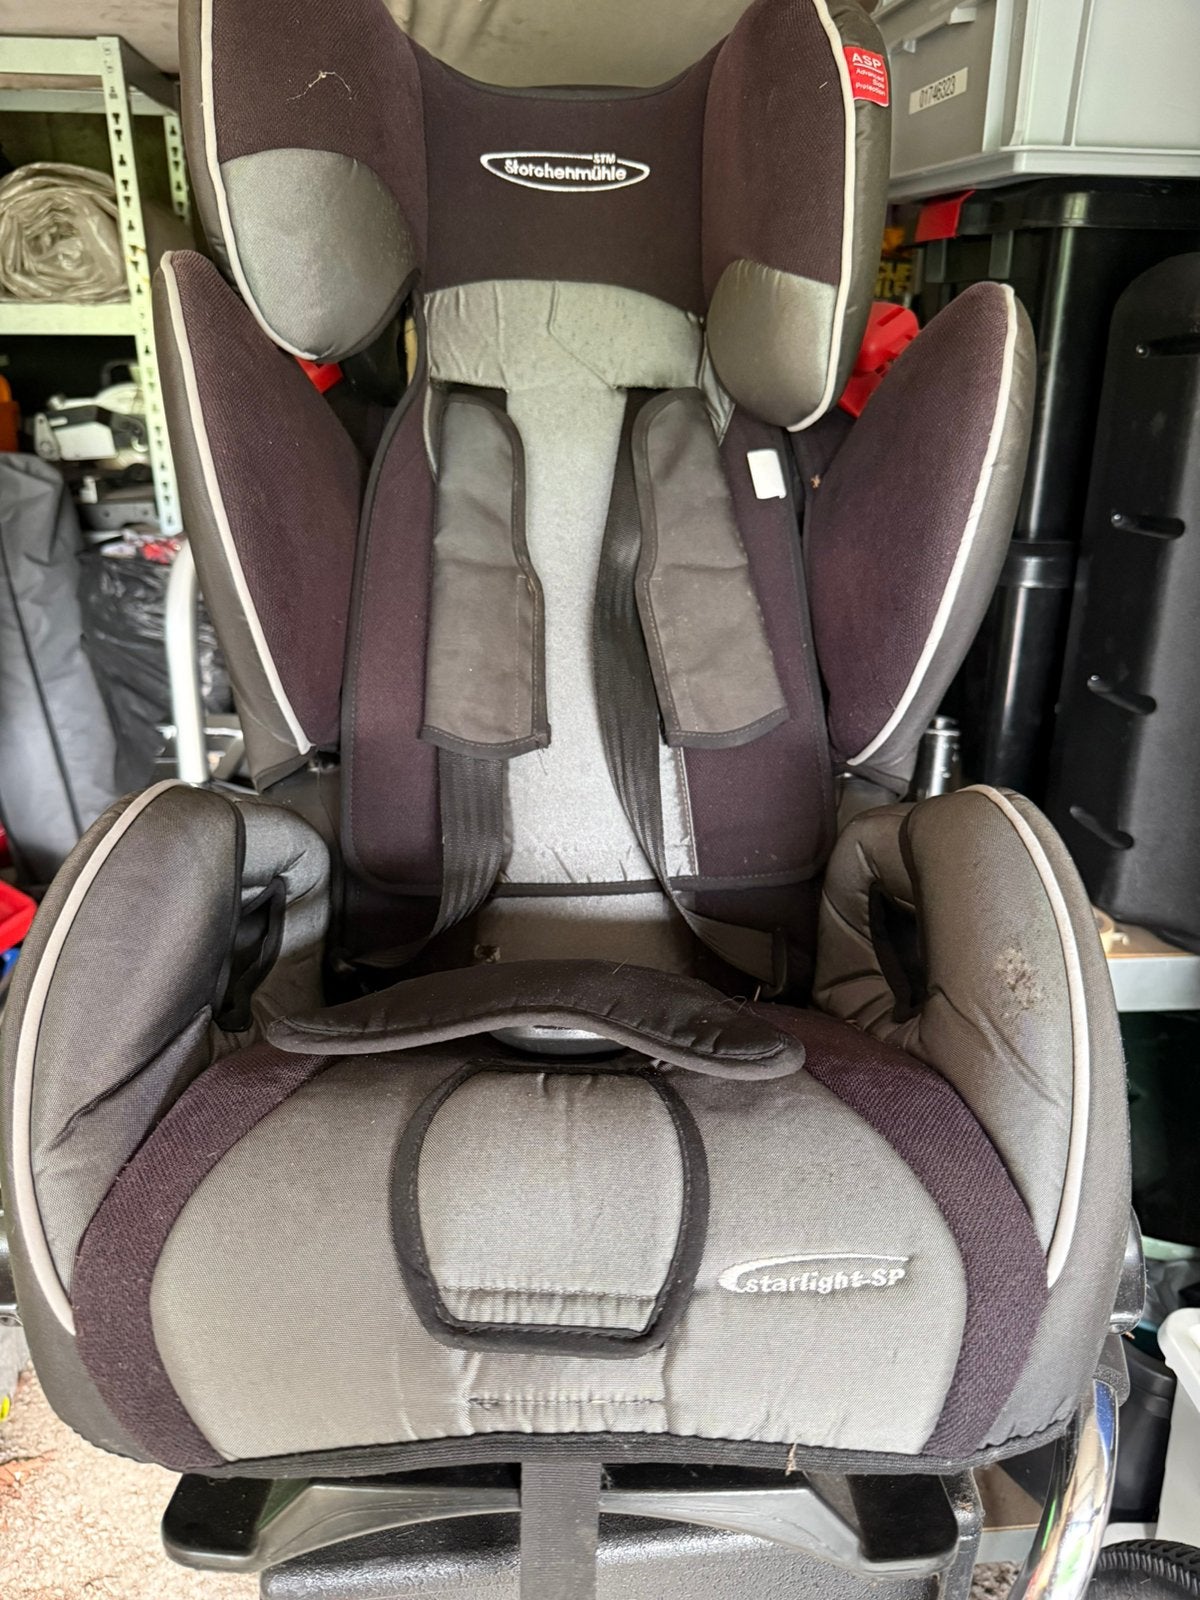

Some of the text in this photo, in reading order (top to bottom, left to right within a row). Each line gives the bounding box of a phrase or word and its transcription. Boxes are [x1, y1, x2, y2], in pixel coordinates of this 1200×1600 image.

[852, 53, 881, 67] ASP
[855, 82, 886, 96] Protection
[592, 153, 616, 164] STM
[504, 159, 628, 181] Storchenmühle
